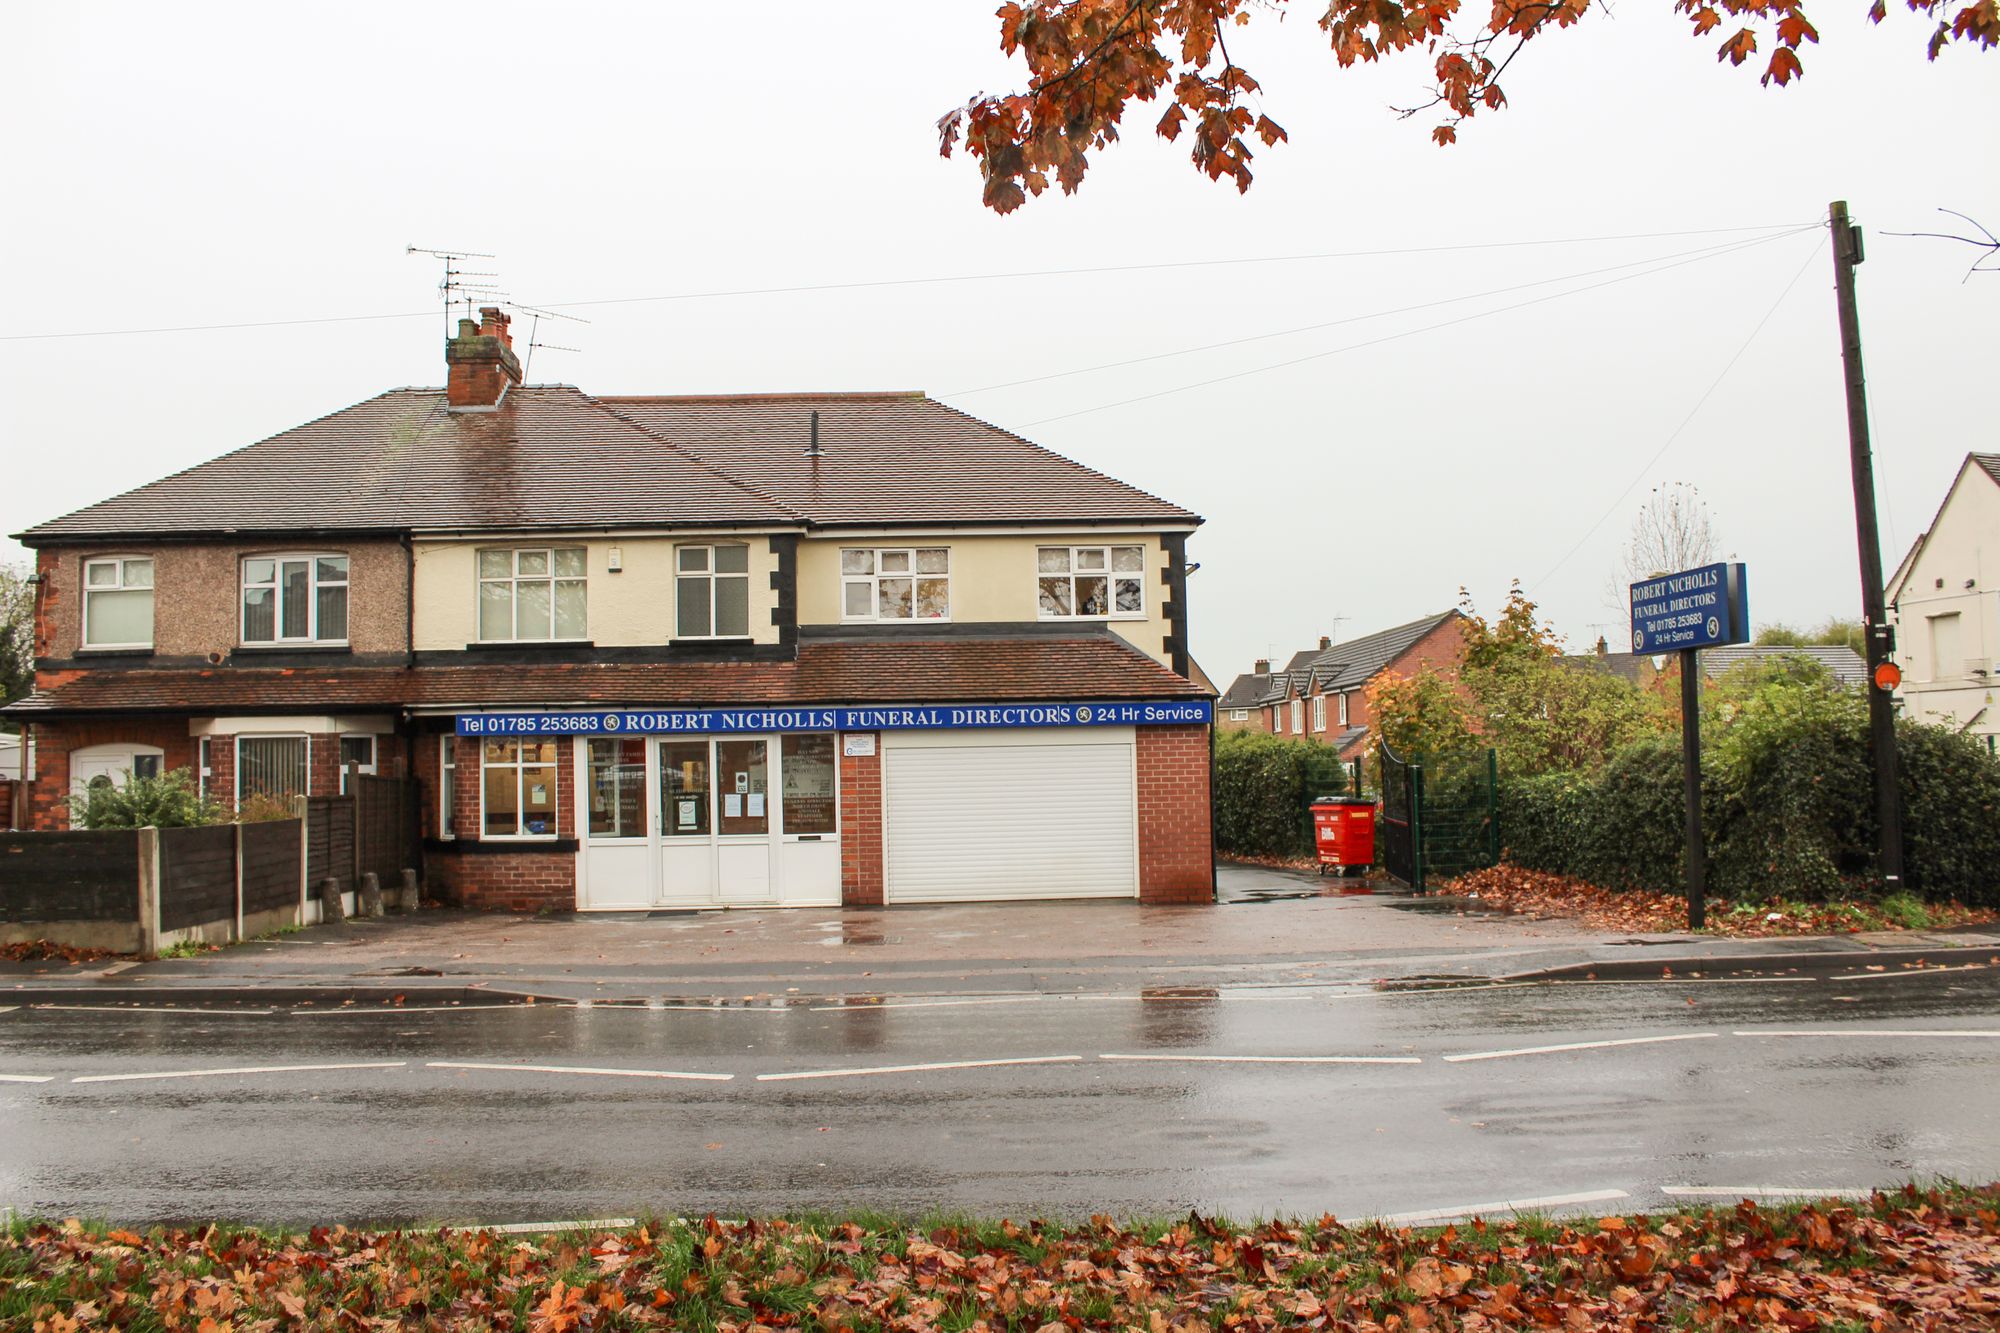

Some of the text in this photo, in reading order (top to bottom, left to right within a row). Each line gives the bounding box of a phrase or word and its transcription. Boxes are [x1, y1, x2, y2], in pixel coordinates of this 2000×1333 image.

[1632, 570, 1717, 602] ROBERT NICHOLLS
[1634, 592, 1716, 620] FUNERAL DIRECTORS
[1646, 612, 1703, 633] Tel 01785 253683
[1655, 630, 1694, 645] 24 Hr Service
[462, 705, 1203, 731] Tel 01785 253683 ROBERT NICHOLLS FUNERAL DIRECTORS 24 Hr Service
